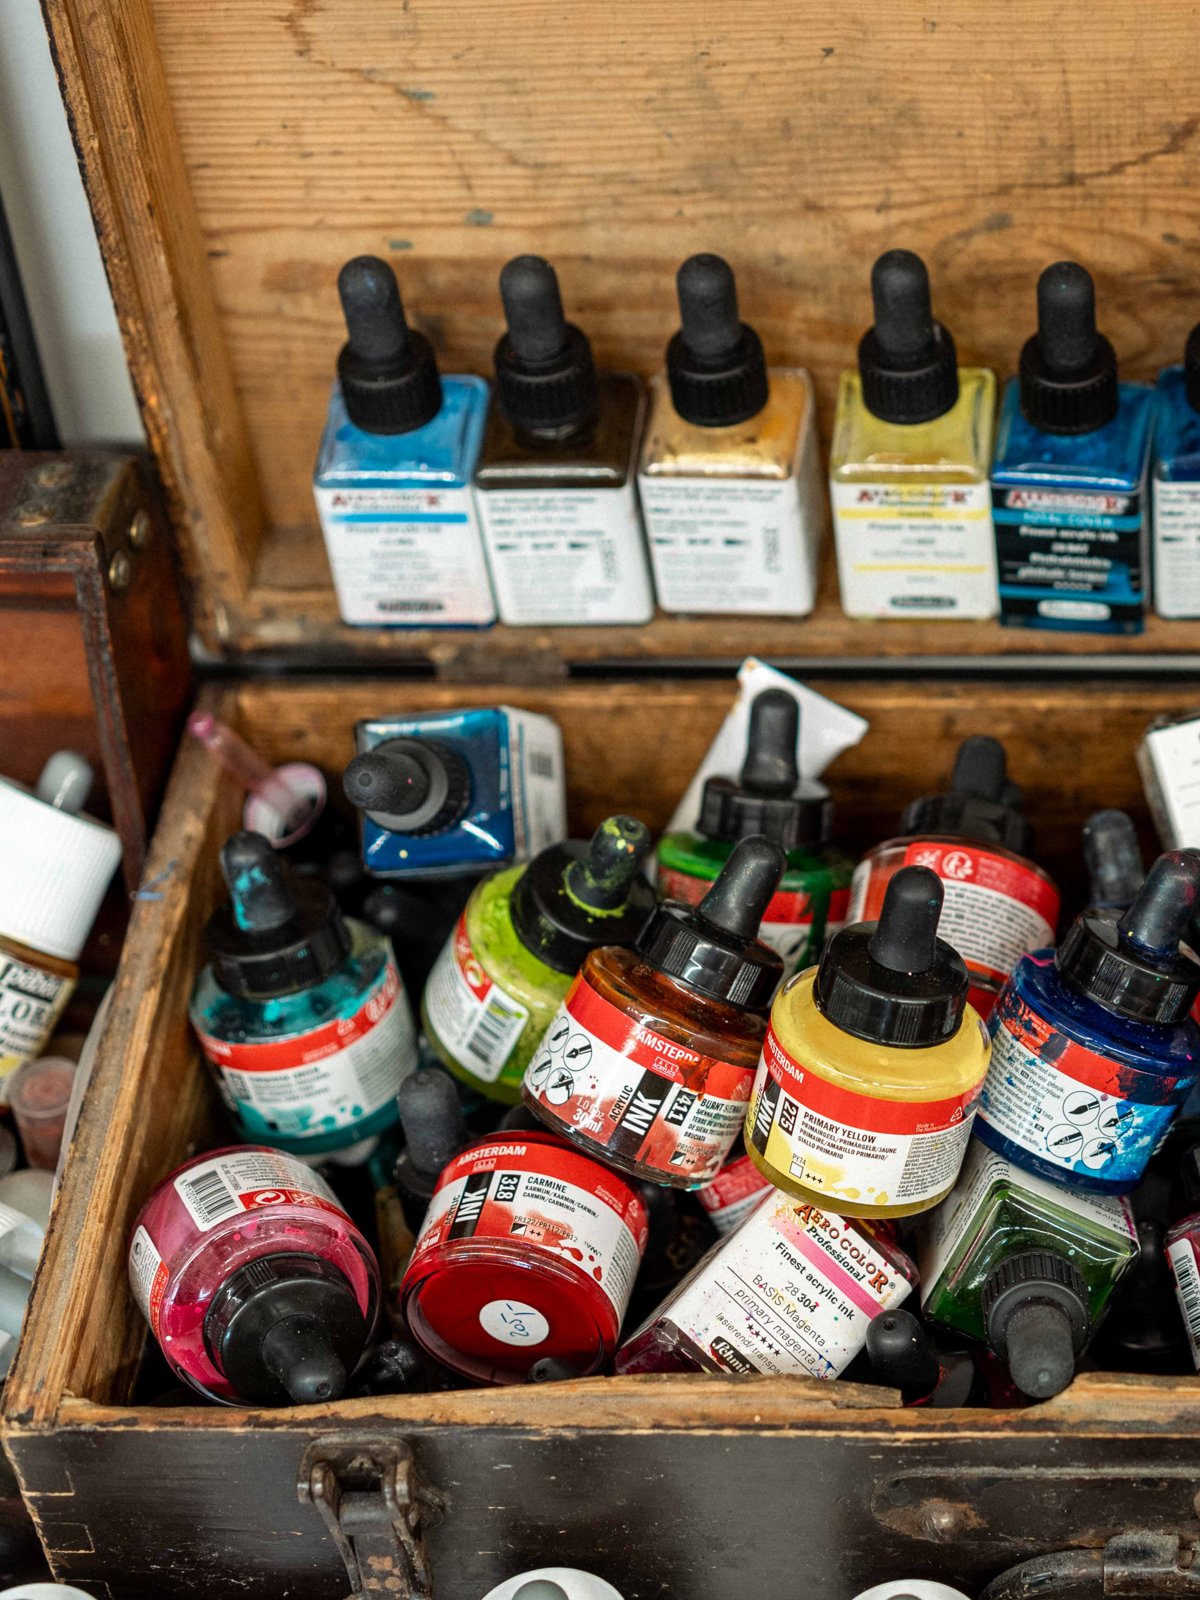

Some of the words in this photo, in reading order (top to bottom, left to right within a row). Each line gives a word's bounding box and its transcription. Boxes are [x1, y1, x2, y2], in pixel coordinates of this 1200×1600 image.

[767, 1033, 804, 1084] AMSTERDAM
[608, 1085, 633, 1122] ACRYLIC
[621, 1091, 662, 1136] INK
[669, 1095, 691, 1121] 411
[700, 1098, 724, 1111] BURNT
[756, 1090, 775, 1138] INK
[781, 1100, 797, 1132] 275
[803, 1111, 840, 1133] PRIMARY
[841, 1128, 876, 1143] YELLOW
[457, 1146, 527, 1167] AMSTERDAM
[797, 1135, 816, 1148] GIALLO
[815, 1144, 843, 1159] PRIMARIO
[496, 1176, 519, 1200] 318
[527, 1176, 568, 1194] CARMINE
[454, 1187, 488, 1222] INK
[793, 1197, 839, 1246] AERO
[806, 1225, 865, 1281] Professional
[775, 1241, 806, 1274] Finest
[805, 1273, 838, 1304] acrylic
[837, 1300, 854, 1320] ink
[784, 1281, 799, 1296] 28
[796, 1292, 817, 1312] 304
[733, 1289, 774, 1324] primary
[772, 1324, 816, 1365] magenta
[752, 1274, 784, 1306] BASIS
[782, 1303, 825, 1346] Magenta
[715, 1312, 754, 1347] lasierend/
[750, 1346, 784, 1381] transpa
